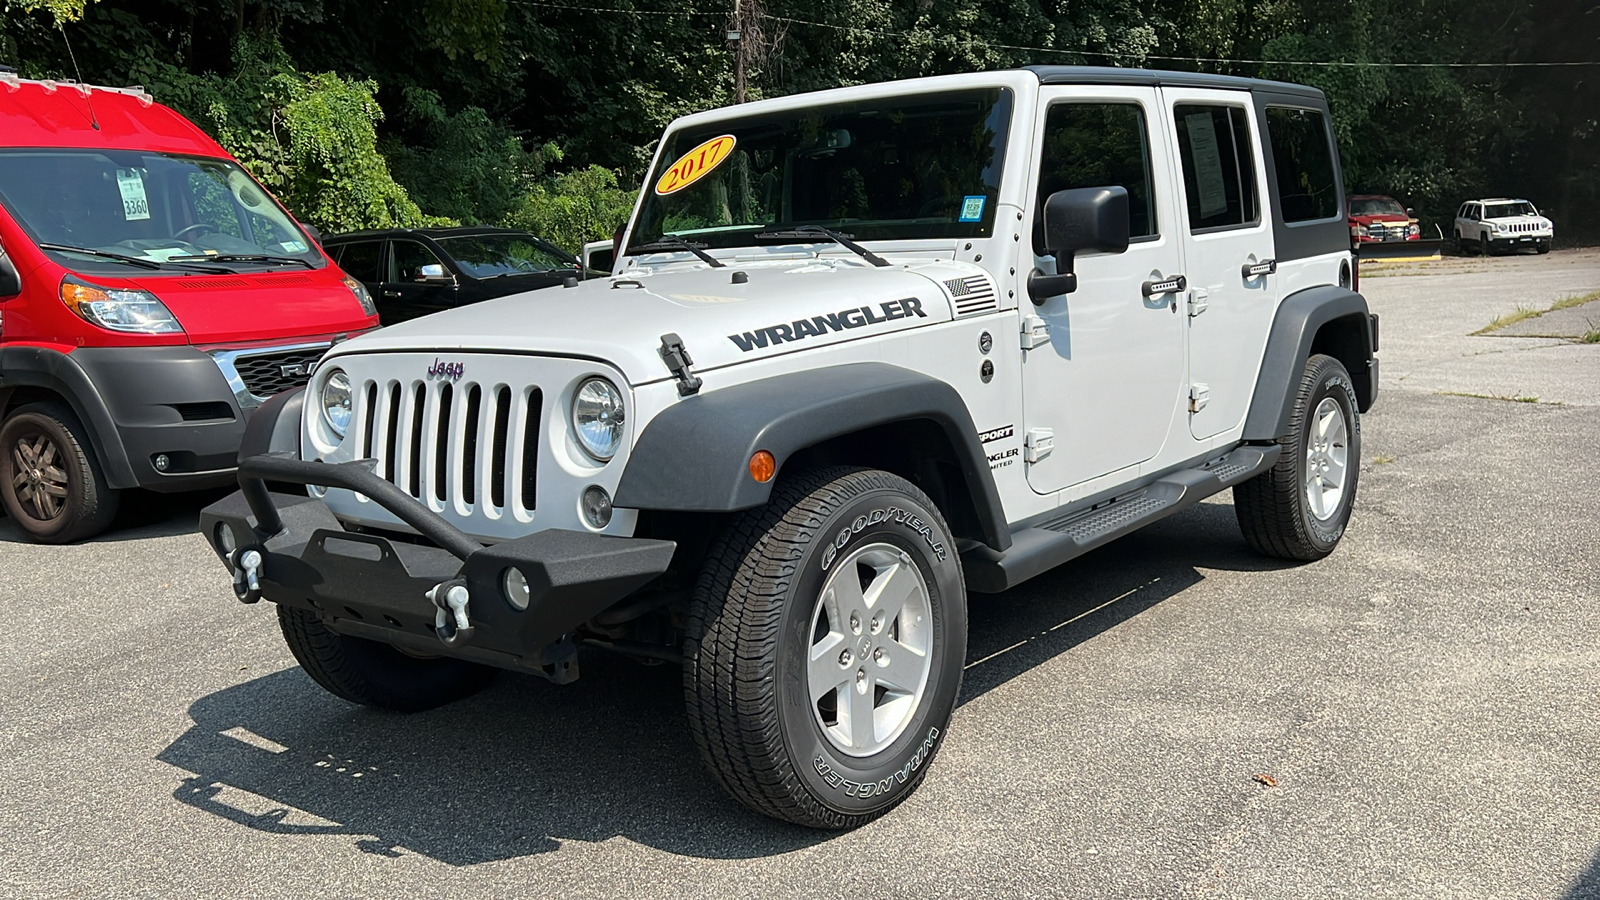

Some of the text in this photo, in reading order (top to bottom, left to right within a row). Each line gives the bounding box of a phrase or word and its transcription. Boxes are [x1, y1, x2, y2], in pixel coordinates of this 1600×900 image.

[666, 140, 723, 190] 2017
[125, 199, 147, 215] 3360
[727, 297, 928, 352] WRANGLER
[428, 357, 464, 381] Jeep
[821, 506, 948, 571] GOODYEAR
[812, 727, 940, 799] WRANGLER
